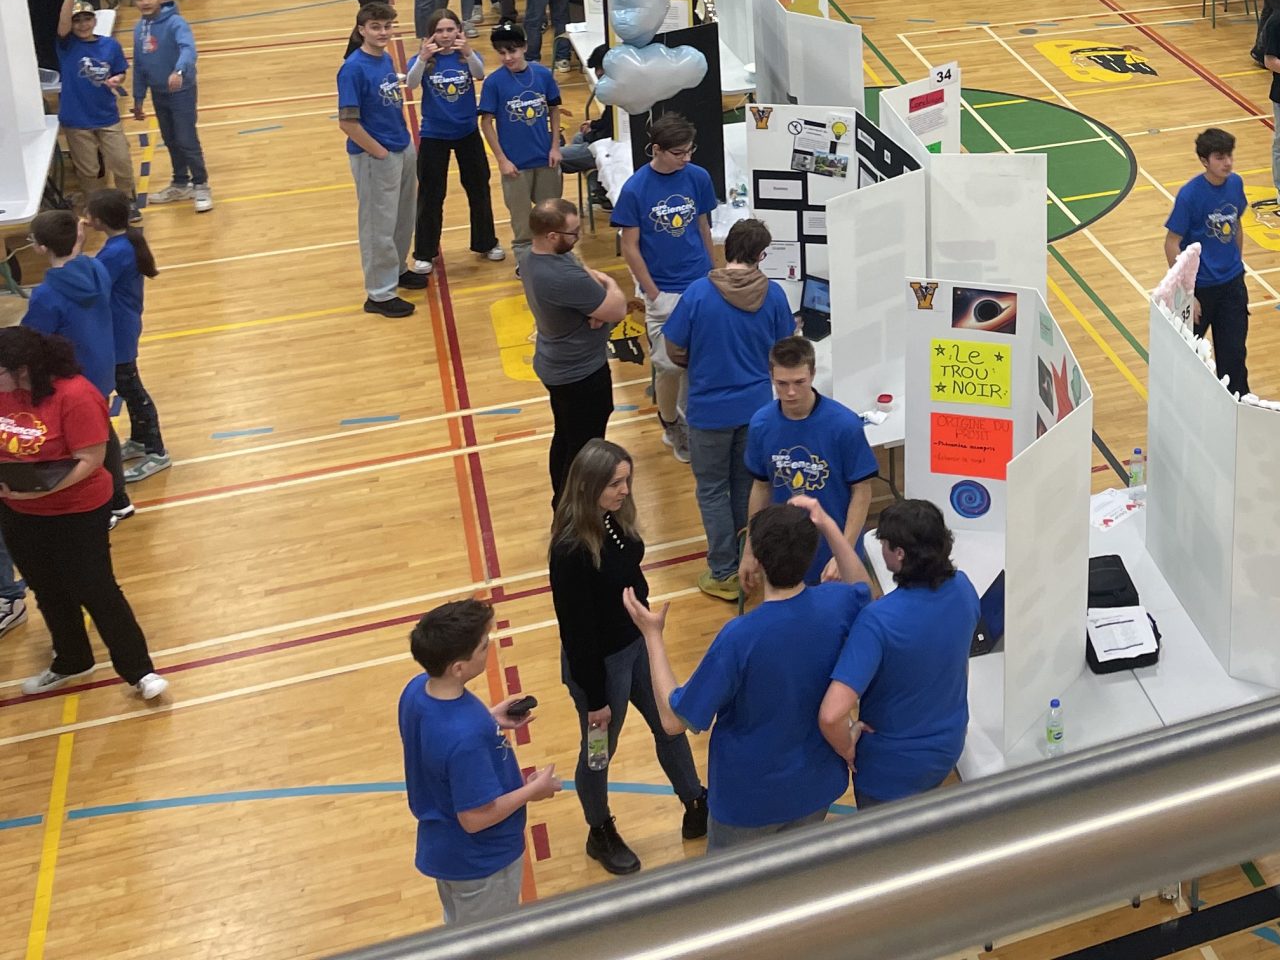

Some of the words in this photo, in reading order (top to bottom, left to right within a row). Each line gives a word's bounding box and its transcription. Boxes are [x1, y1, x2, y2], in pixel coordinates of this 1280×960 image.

[936, 68, 952, 83] 34
[940, 364, 989, 381] TROU
[952, 380, 1003, 399] NOIR
